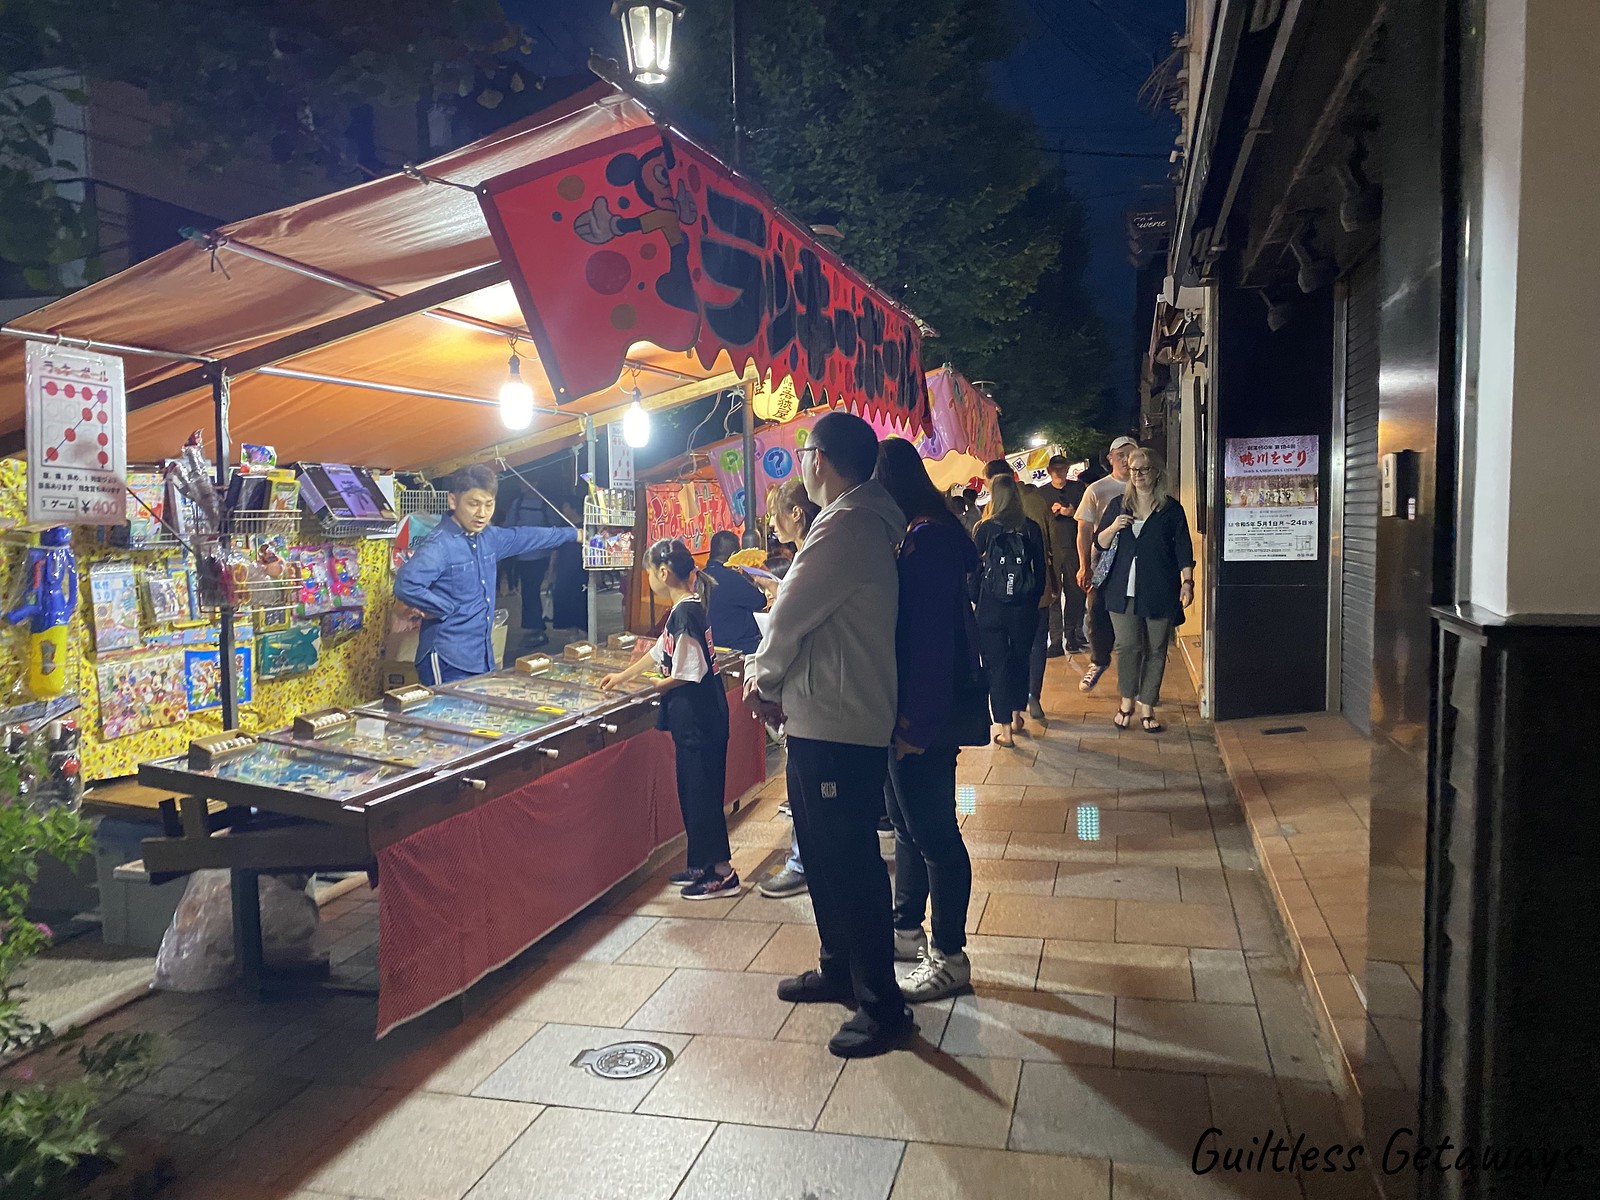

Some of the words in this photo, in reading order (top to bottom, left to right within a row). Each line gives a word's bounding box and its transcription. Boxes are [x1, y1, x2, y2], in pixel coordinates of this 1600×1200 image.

[1240, 450, 1307, 467] 鴨川をどり
[1032, 469, 1047, 480] 氷
[41, 500, 75, 510] 1ゲーム
[81, 500, 119, 515] ¥400
